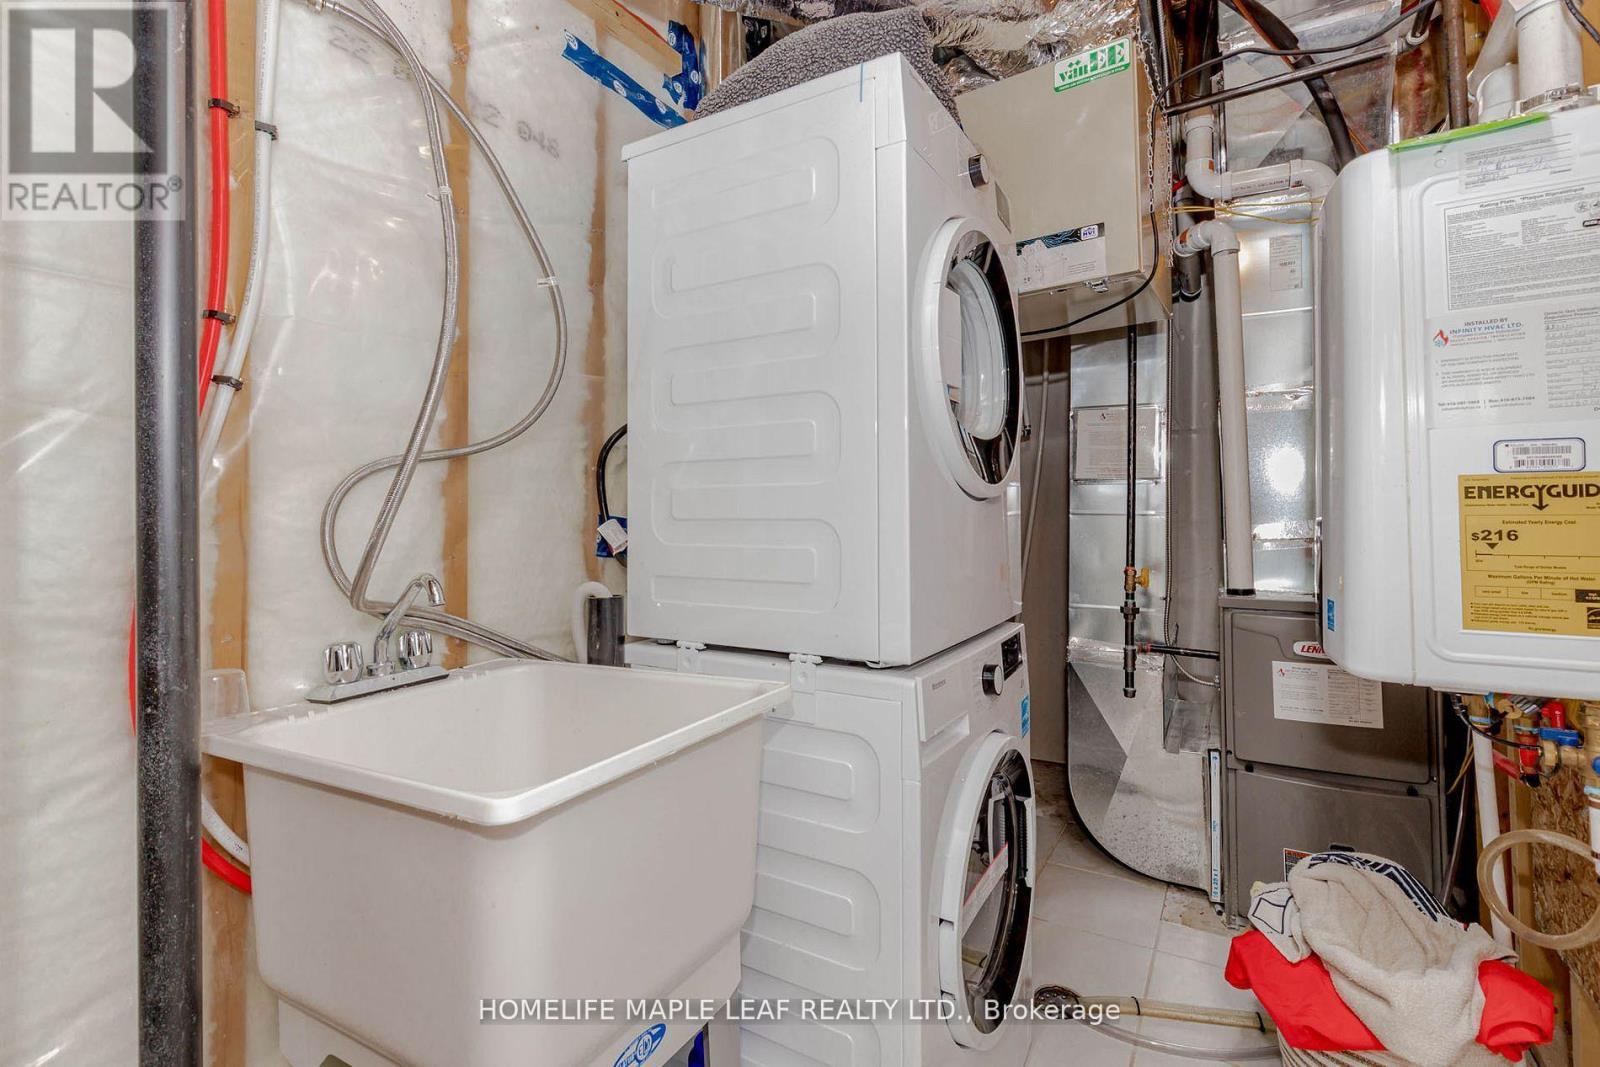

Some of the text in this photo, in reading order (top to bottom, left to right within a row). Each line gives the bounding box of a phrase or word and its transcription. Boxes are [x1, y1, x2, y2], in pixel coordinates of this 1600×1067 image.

[1449, 326, 1482, 335] INFINITY
[1484, 323, 1505, 331] HVAC
[1471, 529, 1519, 541] $216
